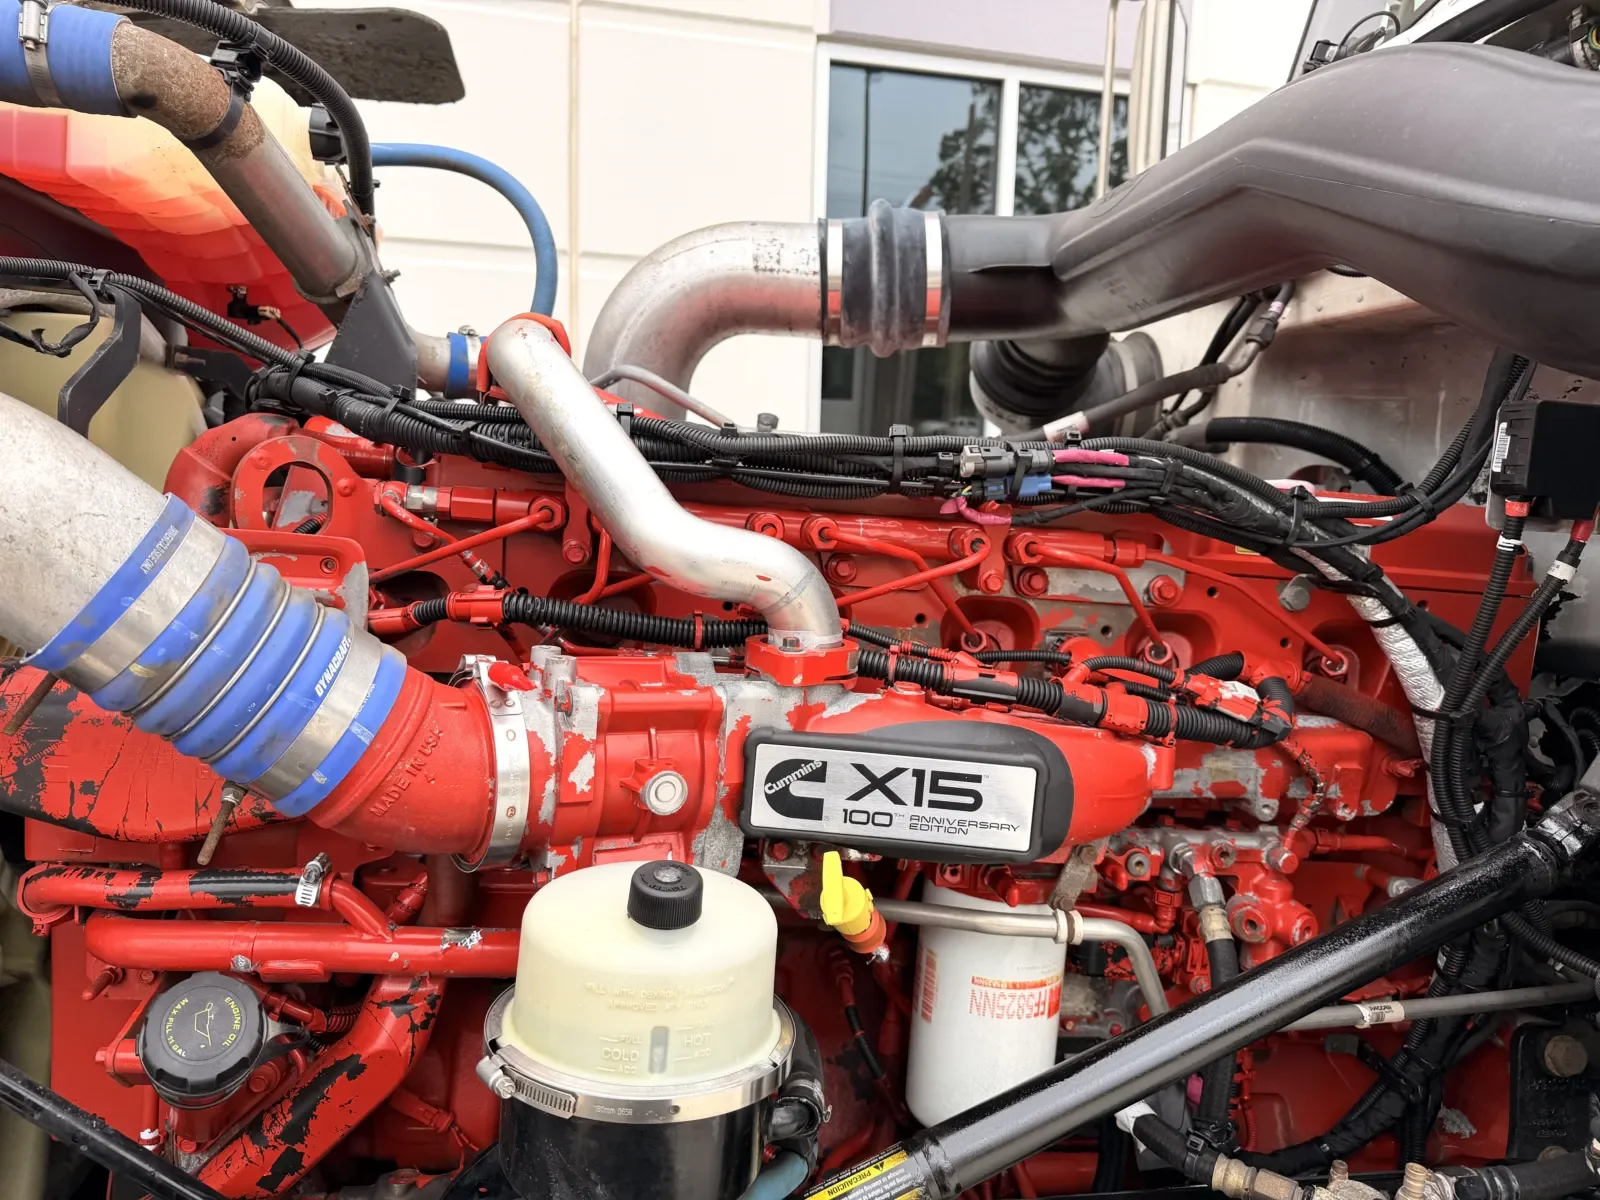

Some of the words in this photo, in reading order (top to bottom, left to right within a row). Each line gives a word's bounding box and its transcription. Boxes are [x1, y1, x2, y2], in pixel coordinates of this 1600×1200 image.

[138, 557, 155, 574] ONLY
[370, 778, 411, 817] MADE
[405, 757, 426, 777] IN
[417, 728, 443, 757] USA
[764, 759, 823, 795] Cummins
[845, 762, 984, 813] X15
[909, 814, 1020, 833] ANNIVERSARY
[909, 823, 969, 836] EDITION
[612, 988, 635, 998] WITH
[171, 998, 189, 1015] MAX
[969, 988, 1048, 1020] FF5825NN
[224, 996, 241, 1030] ENGINE
[165, 1017, 174, 1034] FILL
[222, 1033, 237, 1047] OIL
[620, 1035, 643, 1044] FULL
[684, 1032, 712, 1046] HOT
[172, 1044, 187, 1057] GAL
[601, 1047, 640, 1062] COLD
[693, 1048, 711, 1058] ADD
[617, 1065, 637, 1074] ADD
[827, 1169, 872, 1196] PRECAUCION
